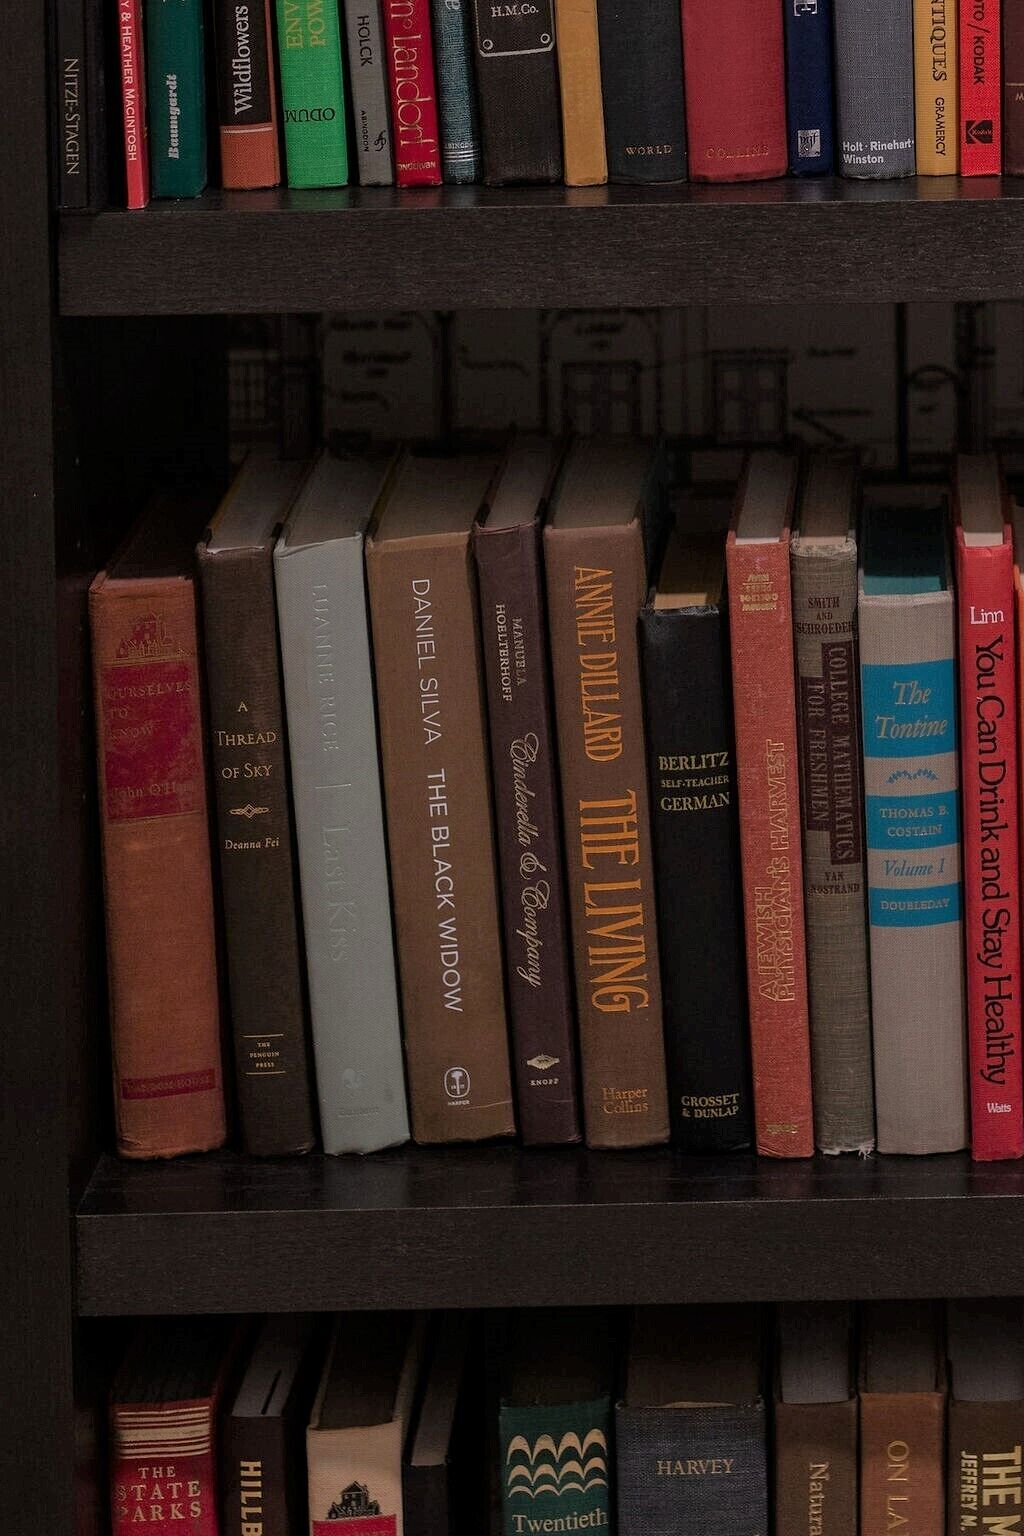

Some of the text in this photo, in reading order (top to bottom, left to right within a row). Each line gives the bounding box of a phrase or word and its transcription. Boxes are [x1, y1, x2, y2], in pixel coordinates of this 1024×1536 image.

[232, 4, 251, 115] Wildflowers
[935, 97, 945, 156] GRAMERCY
[970, 606, 1004, 625] Linn
[658, 752, 729, 772] BERLITZ
[411, 577, 464, 1013] DANIEL SILVA THE BLACK WIDOW
[574, 565, 648, 1014] ANNIE DILLARD THE LIVING
[660, 792, 730, 811] GERMAN
[975, 637, 1017, 1085] You Can Drink and Stay Healthy
[987, 1102, 1011, 1113] Watts
[656, 1459, 734, 1476] HARVEY
[512, 1510, 607, 1534] Twentieth
